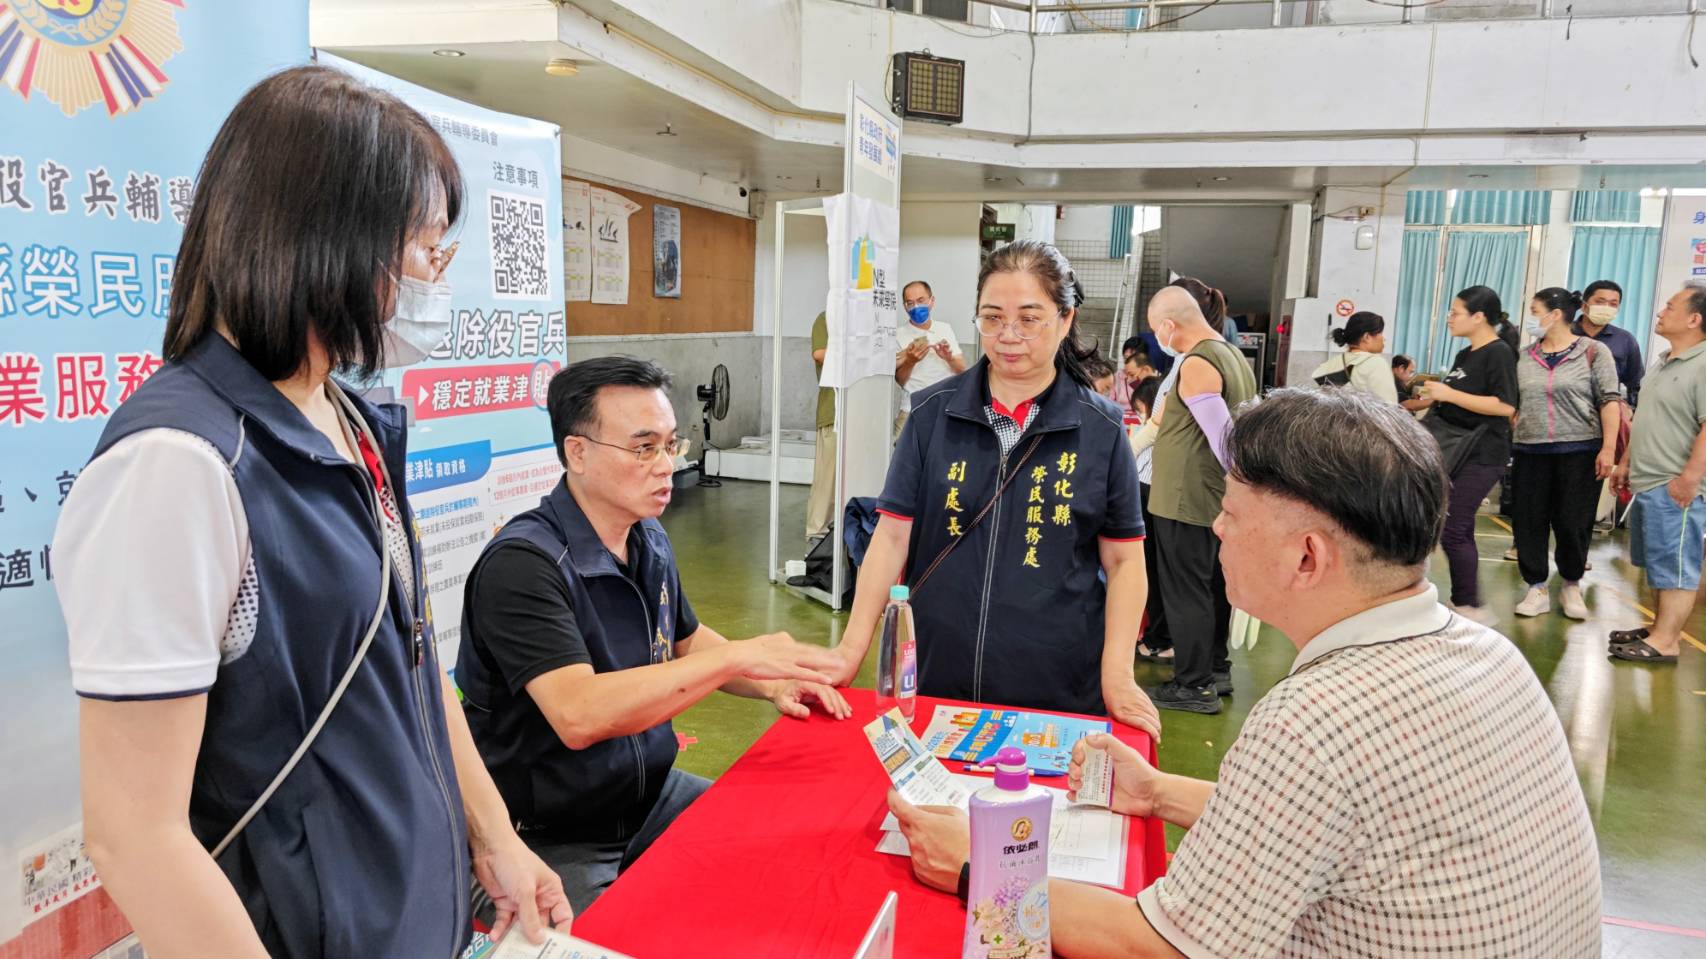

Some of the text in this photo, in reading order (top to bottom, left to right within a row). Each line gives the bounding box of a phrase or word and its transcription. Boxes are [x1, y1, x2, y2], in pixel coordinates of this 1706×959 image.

[493, 160, 539, 188] 注意事項
[432, 369, 551, 411] 穩定就業津貼
[944, 460, 966, 537] 副處長
[1023, 465, 1048, 568] 榮民服務處
[1052, 451, 1078, 527] 彰化縣
[1003, 840, 1039, 855] 依必朗
